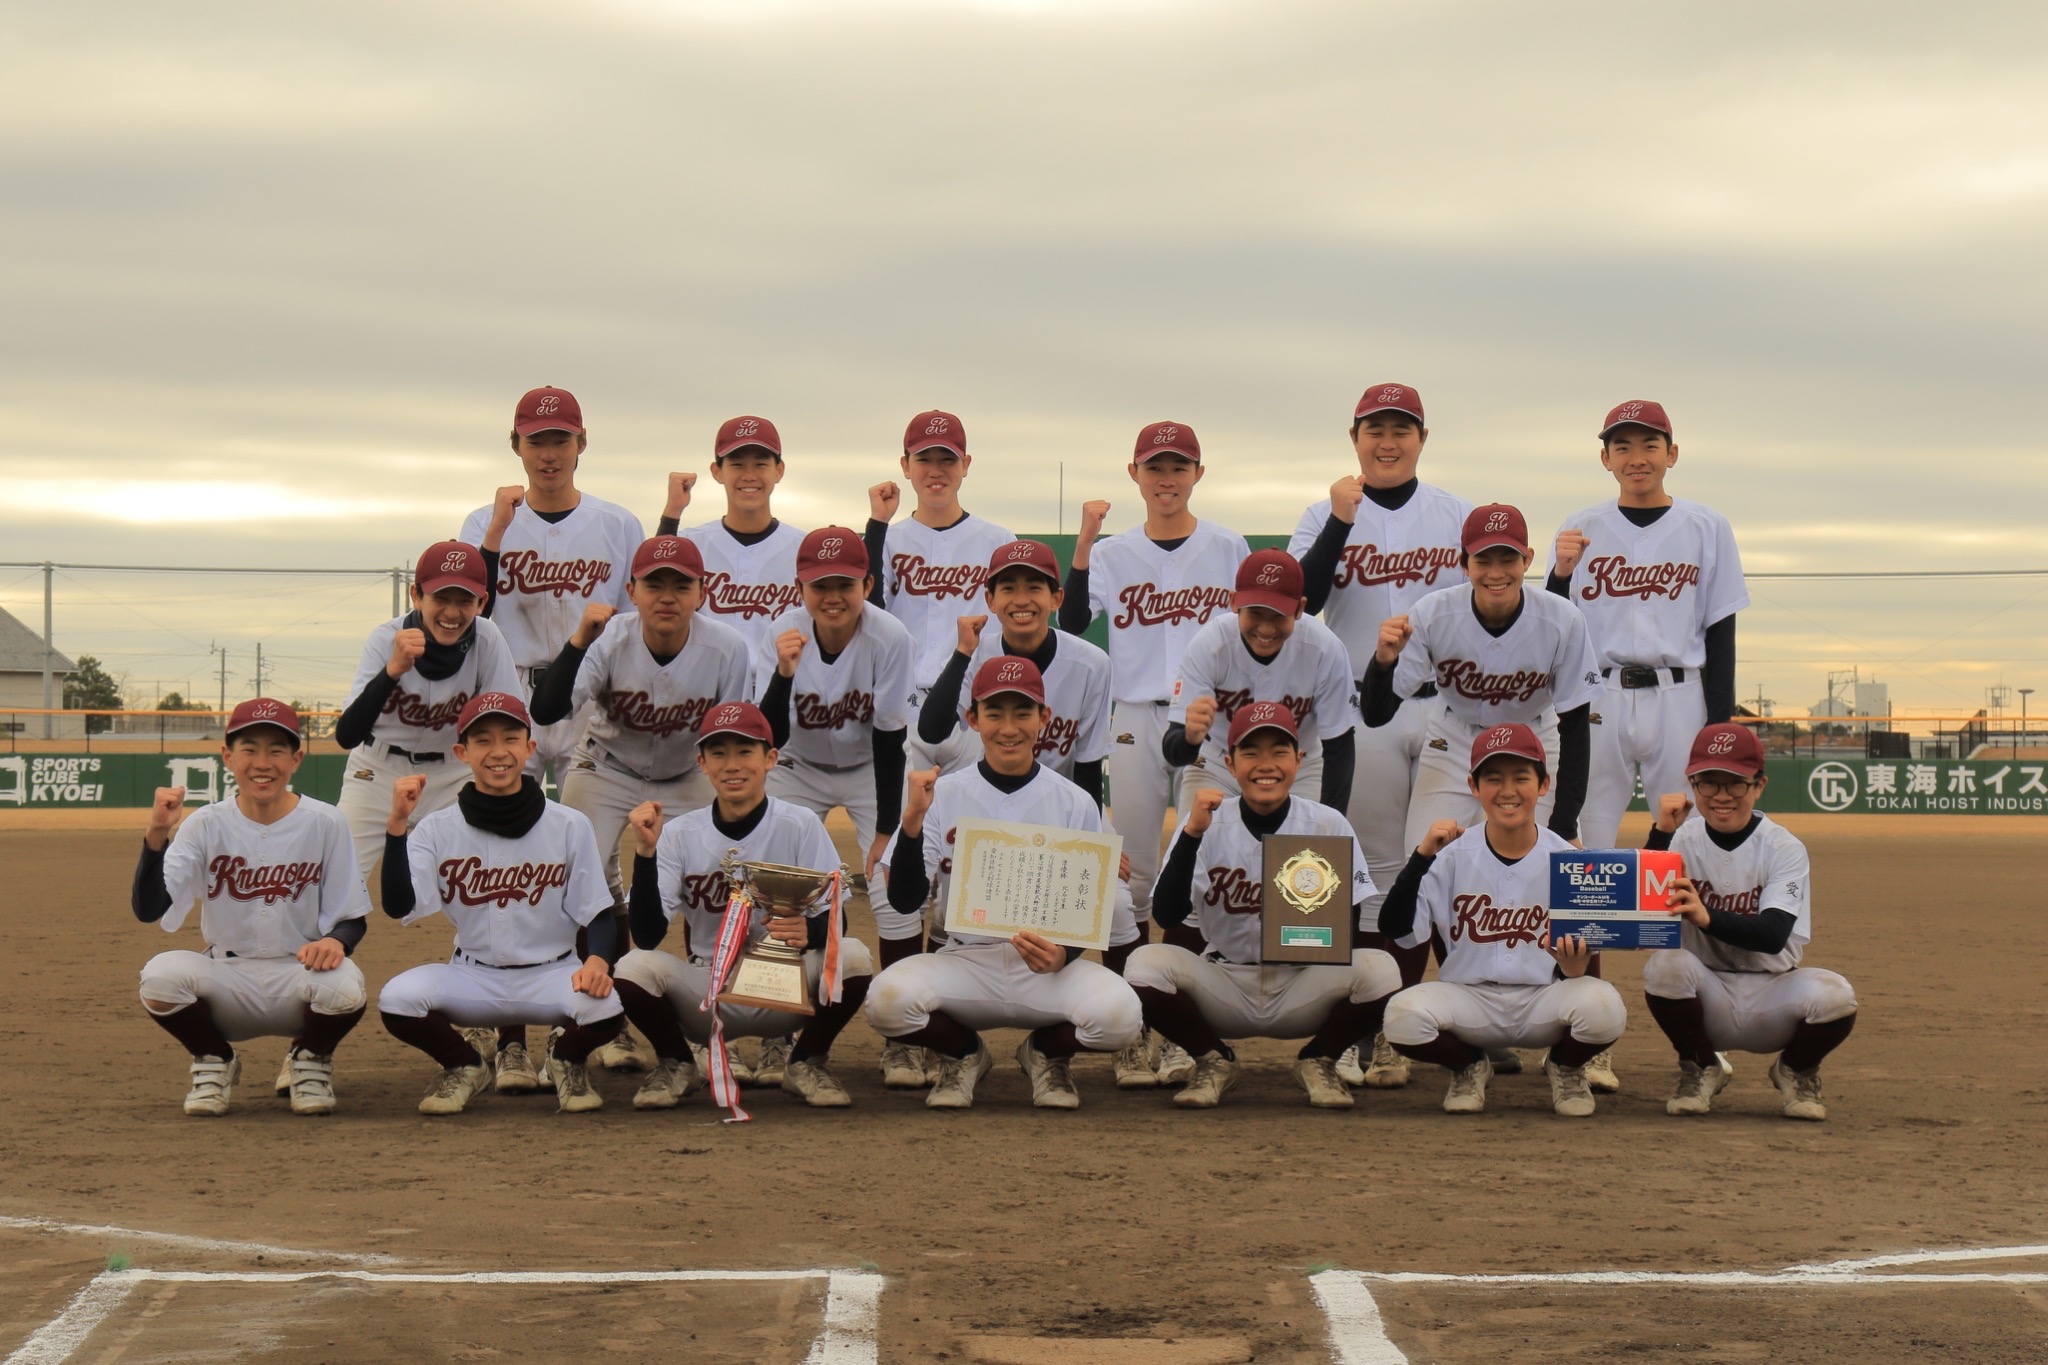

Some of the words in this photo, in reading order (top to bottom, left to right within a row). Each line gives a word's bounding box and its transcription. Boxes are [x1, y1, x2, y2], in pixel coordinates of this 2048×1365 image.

[891, 553, 988, 601] Knagoy
[607, 691, 714, 738] Knagoy
[794, 689, 874, 730] Knagoy
[31, 758, 101, 772] SPORTS
[31, 771, 80, 784] CUBE
[31, 784, 104, 801] KYOEI
[1865, 764, 2048, 796] 東海ホイス
[1865, 797, 1918, 811] TOKAI
[1926, 798, 1980, 811] HOIST
[1074, 868, 1091, 911] 表彰状
[1570, 875, 1616, 886] BALL
[1645, 869, 1676, 896] M
[1450, 893, 1549, 949] Knago
